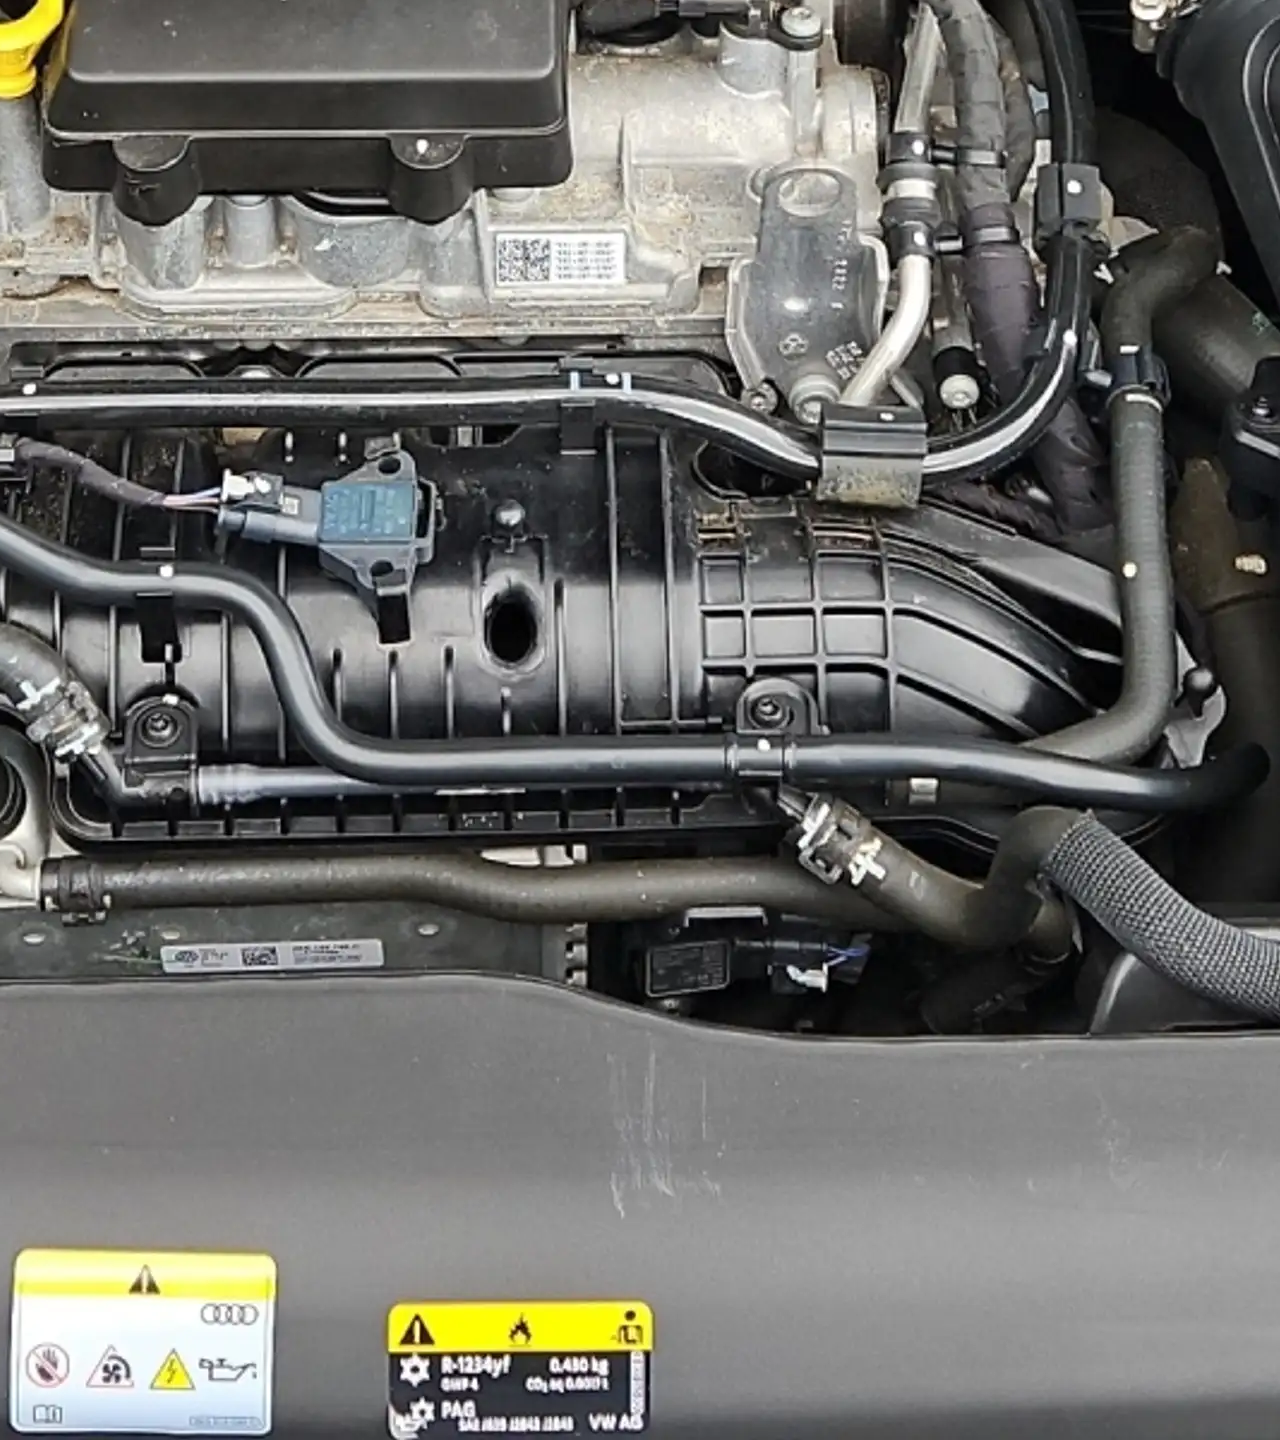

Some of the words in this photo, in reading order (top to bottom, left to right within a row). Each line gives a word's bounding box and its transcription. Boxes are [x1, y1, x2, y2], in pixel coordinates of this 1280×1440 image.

[440, 1354, 512, 1378] R-1234yf
[590, 1356, 610, 1378] kg
[440, 1400, 477, 1419] PAG
[588, 1413, 618, 1431] VW
[618, 1412, 644, 1431] AG
